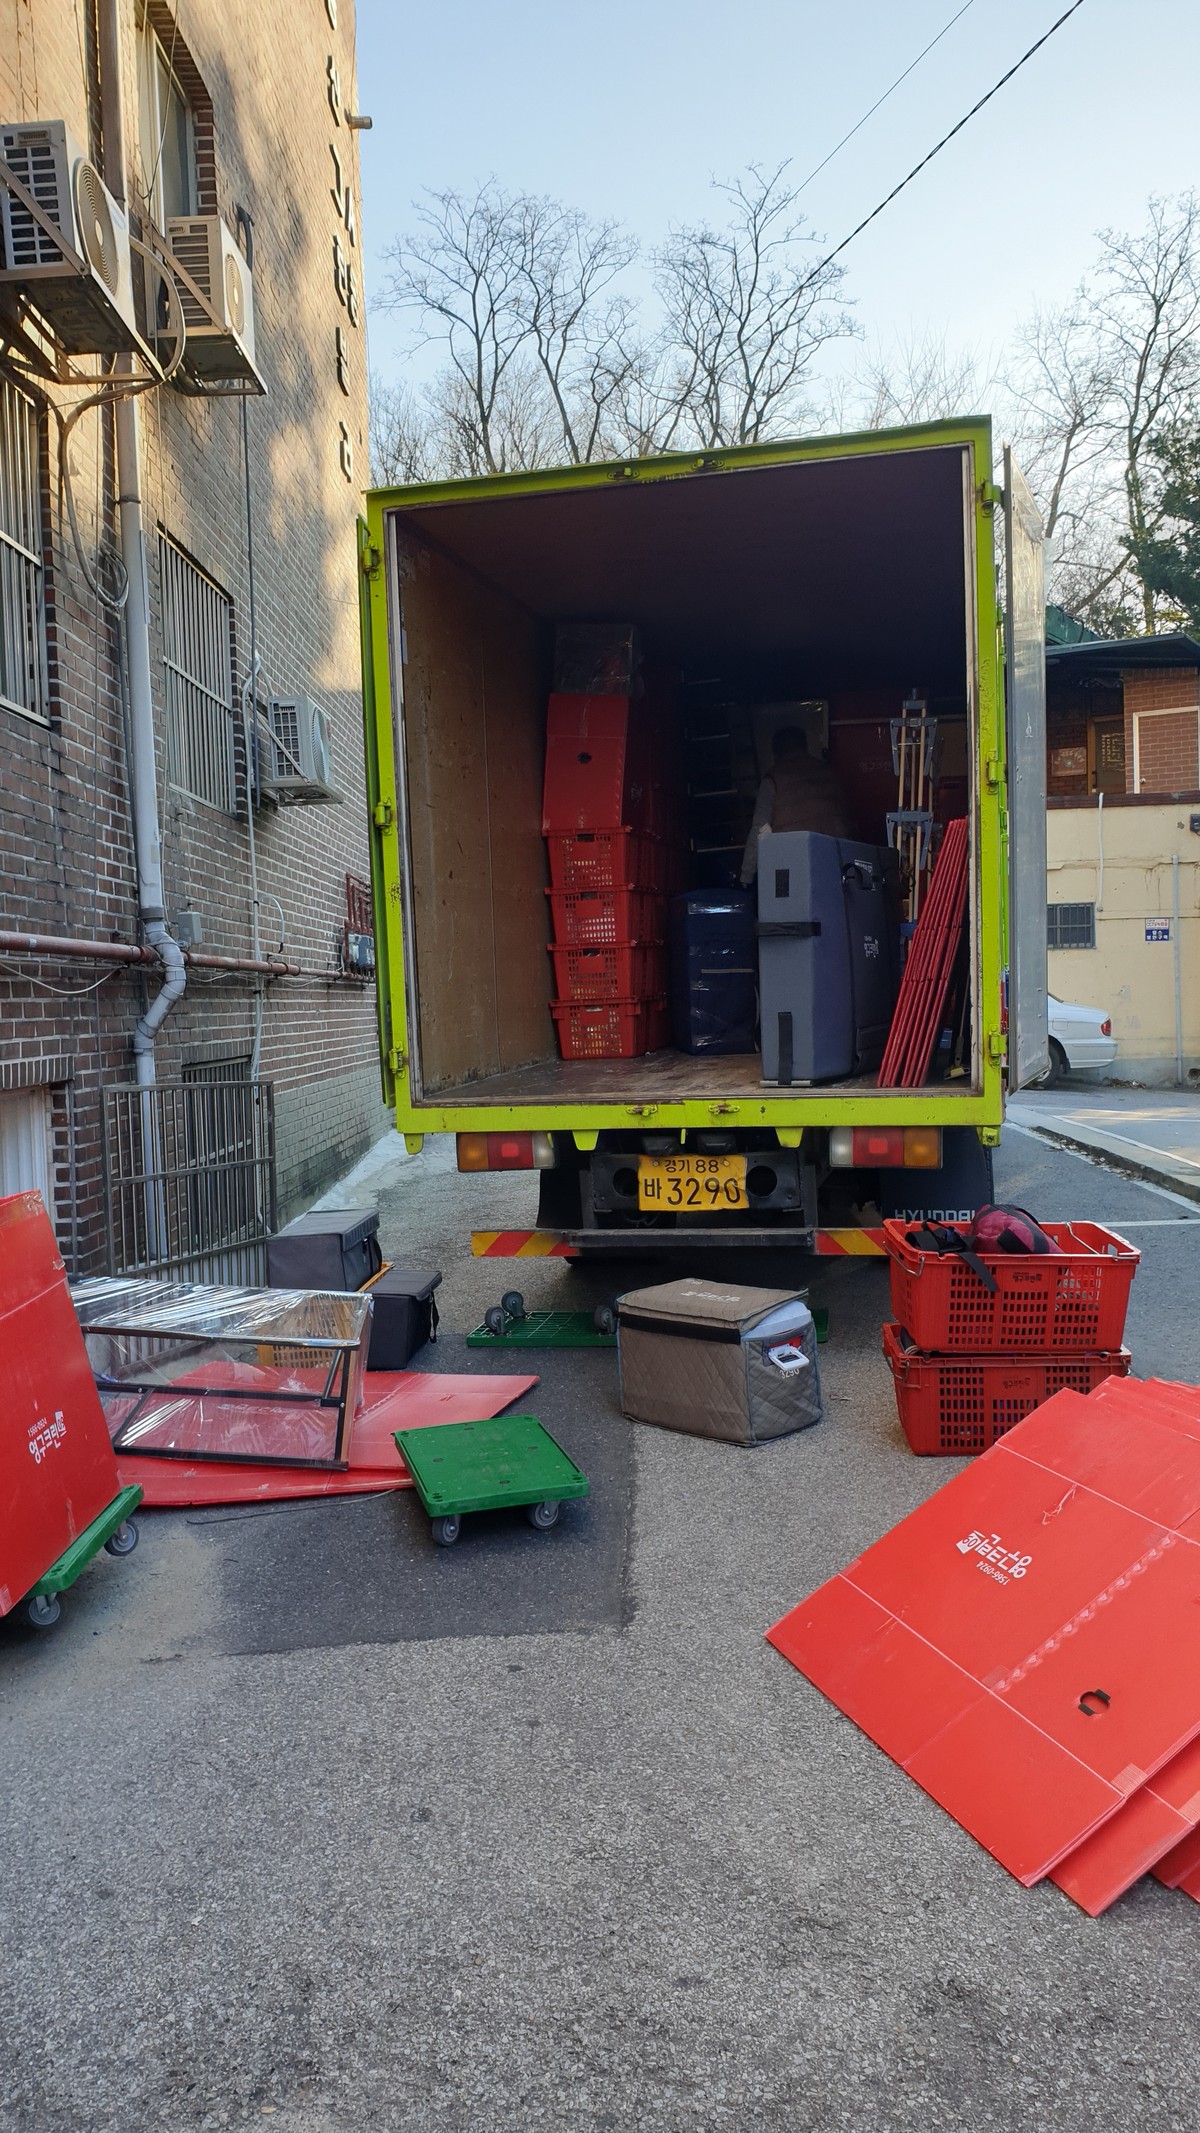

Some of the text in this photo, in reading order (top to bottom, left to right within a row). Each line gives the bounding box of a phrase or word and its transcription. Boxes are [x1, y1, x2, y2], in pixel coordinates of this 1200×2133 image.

[665, 1159, 719, 1173] 경기 88
[895, 1209, 975, 1222] HYUNDAI
[28, 1422, 61, 1464] 영구크린
[977, 1533, 1032, 1578] 영구크린
[976, 1560, 1010, 1586] 1566-0924
